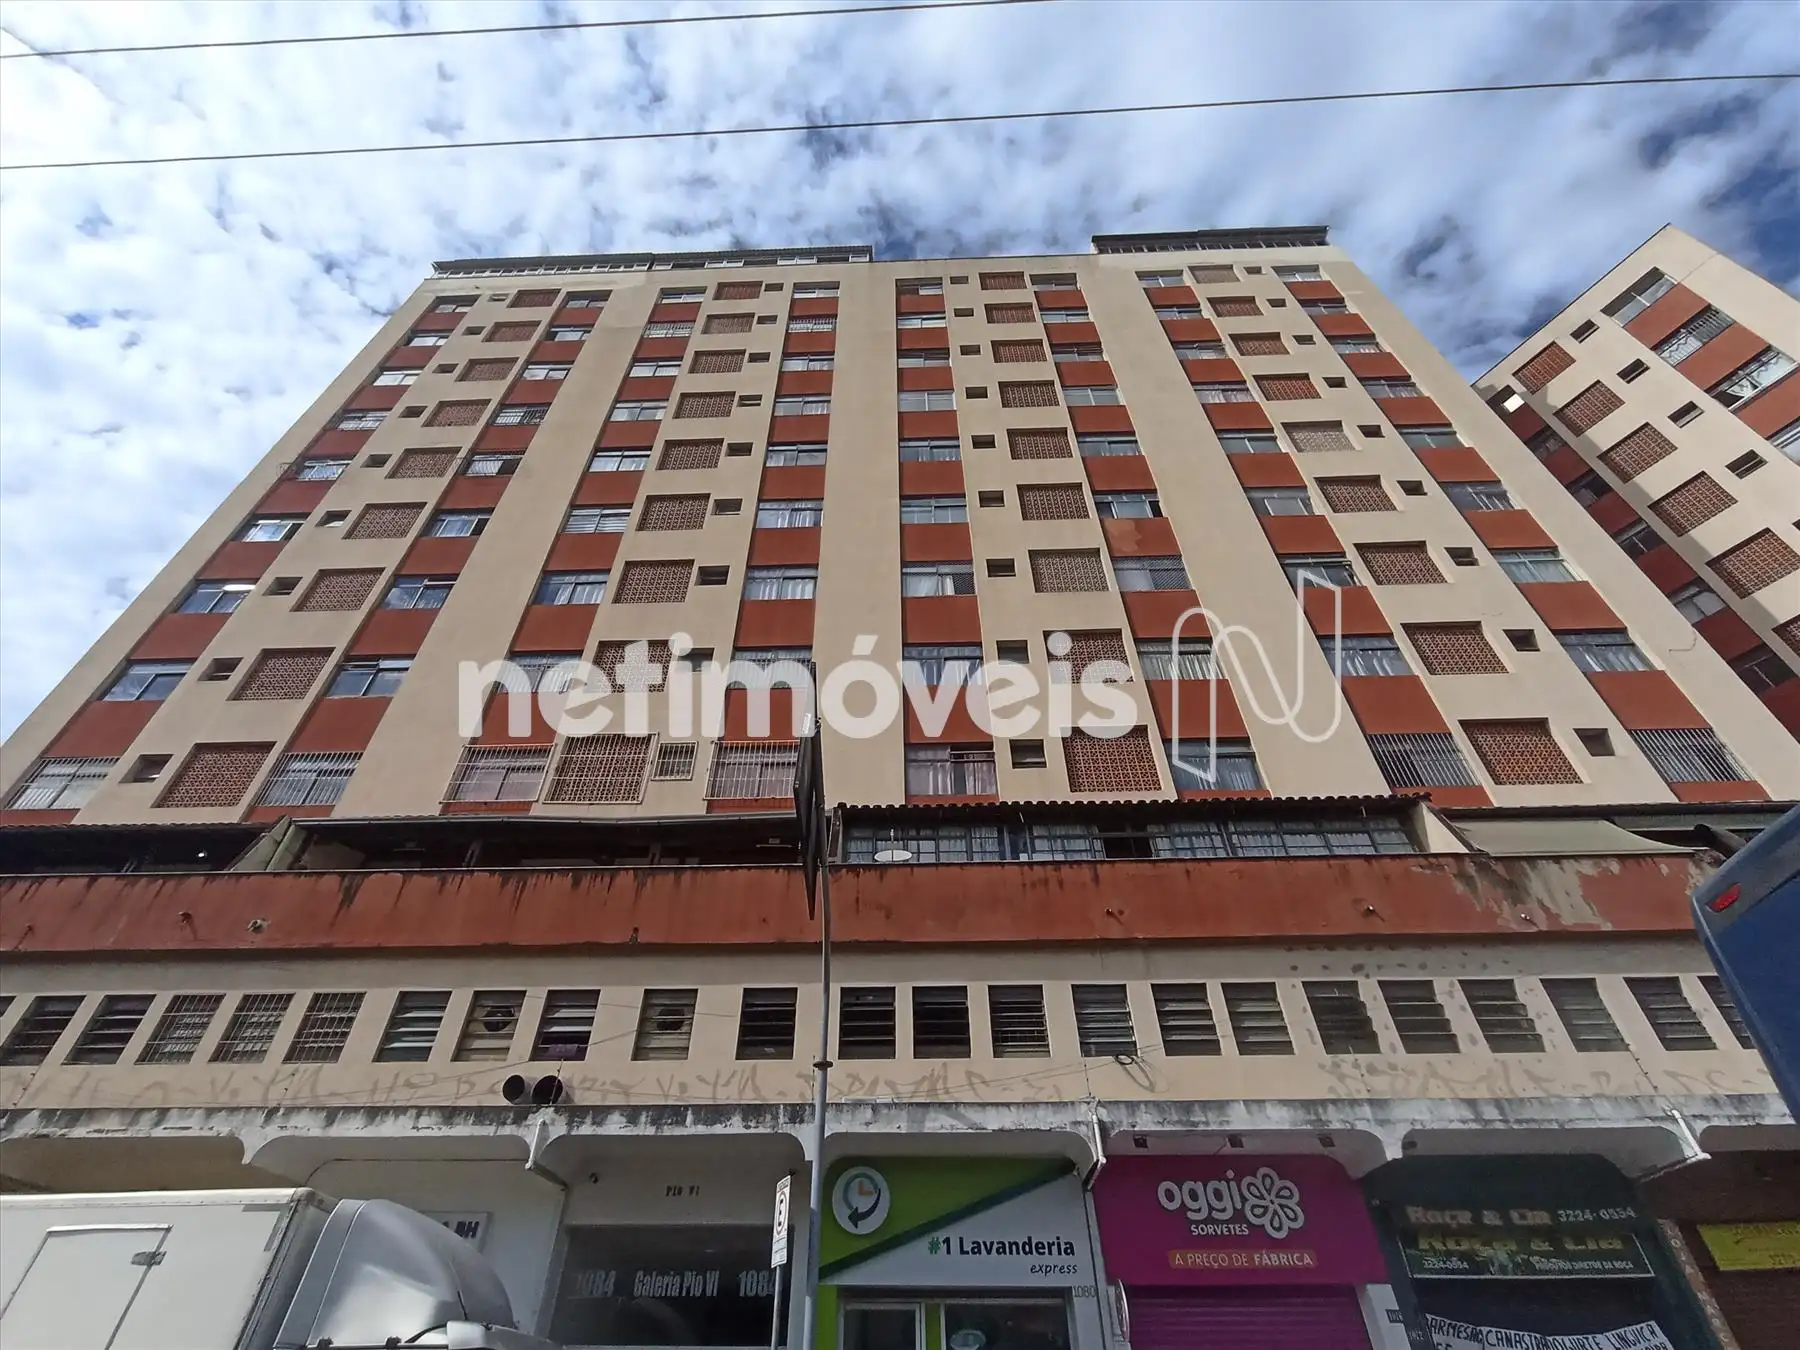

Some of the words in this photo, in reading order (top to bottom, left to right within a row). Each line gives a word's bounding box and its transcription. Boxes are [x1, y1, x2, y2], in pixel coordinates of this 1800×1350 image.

[1157, 1169, 1242, 1220] oggi
[1190, 1223, 1249, 1236] SORVETES
[928, 1236, 951, 1255] #1
[959, 1236, 1075, 1256] Lavanderia
[1175, 1252, 1184, 1265] A
[1187, 1251, 1229, 1268] PREÇO
[1232, 1253, 1249, 1266] DE
[1254, 1250, 1314, 1266] FÁBRICA
[1030, 1263, 1078, 1277] express
[633, 1269, 681, 1297] Galeria
[682, 1269, 703, 1297] Pio
[706, 1269, 720, 1297] VI
